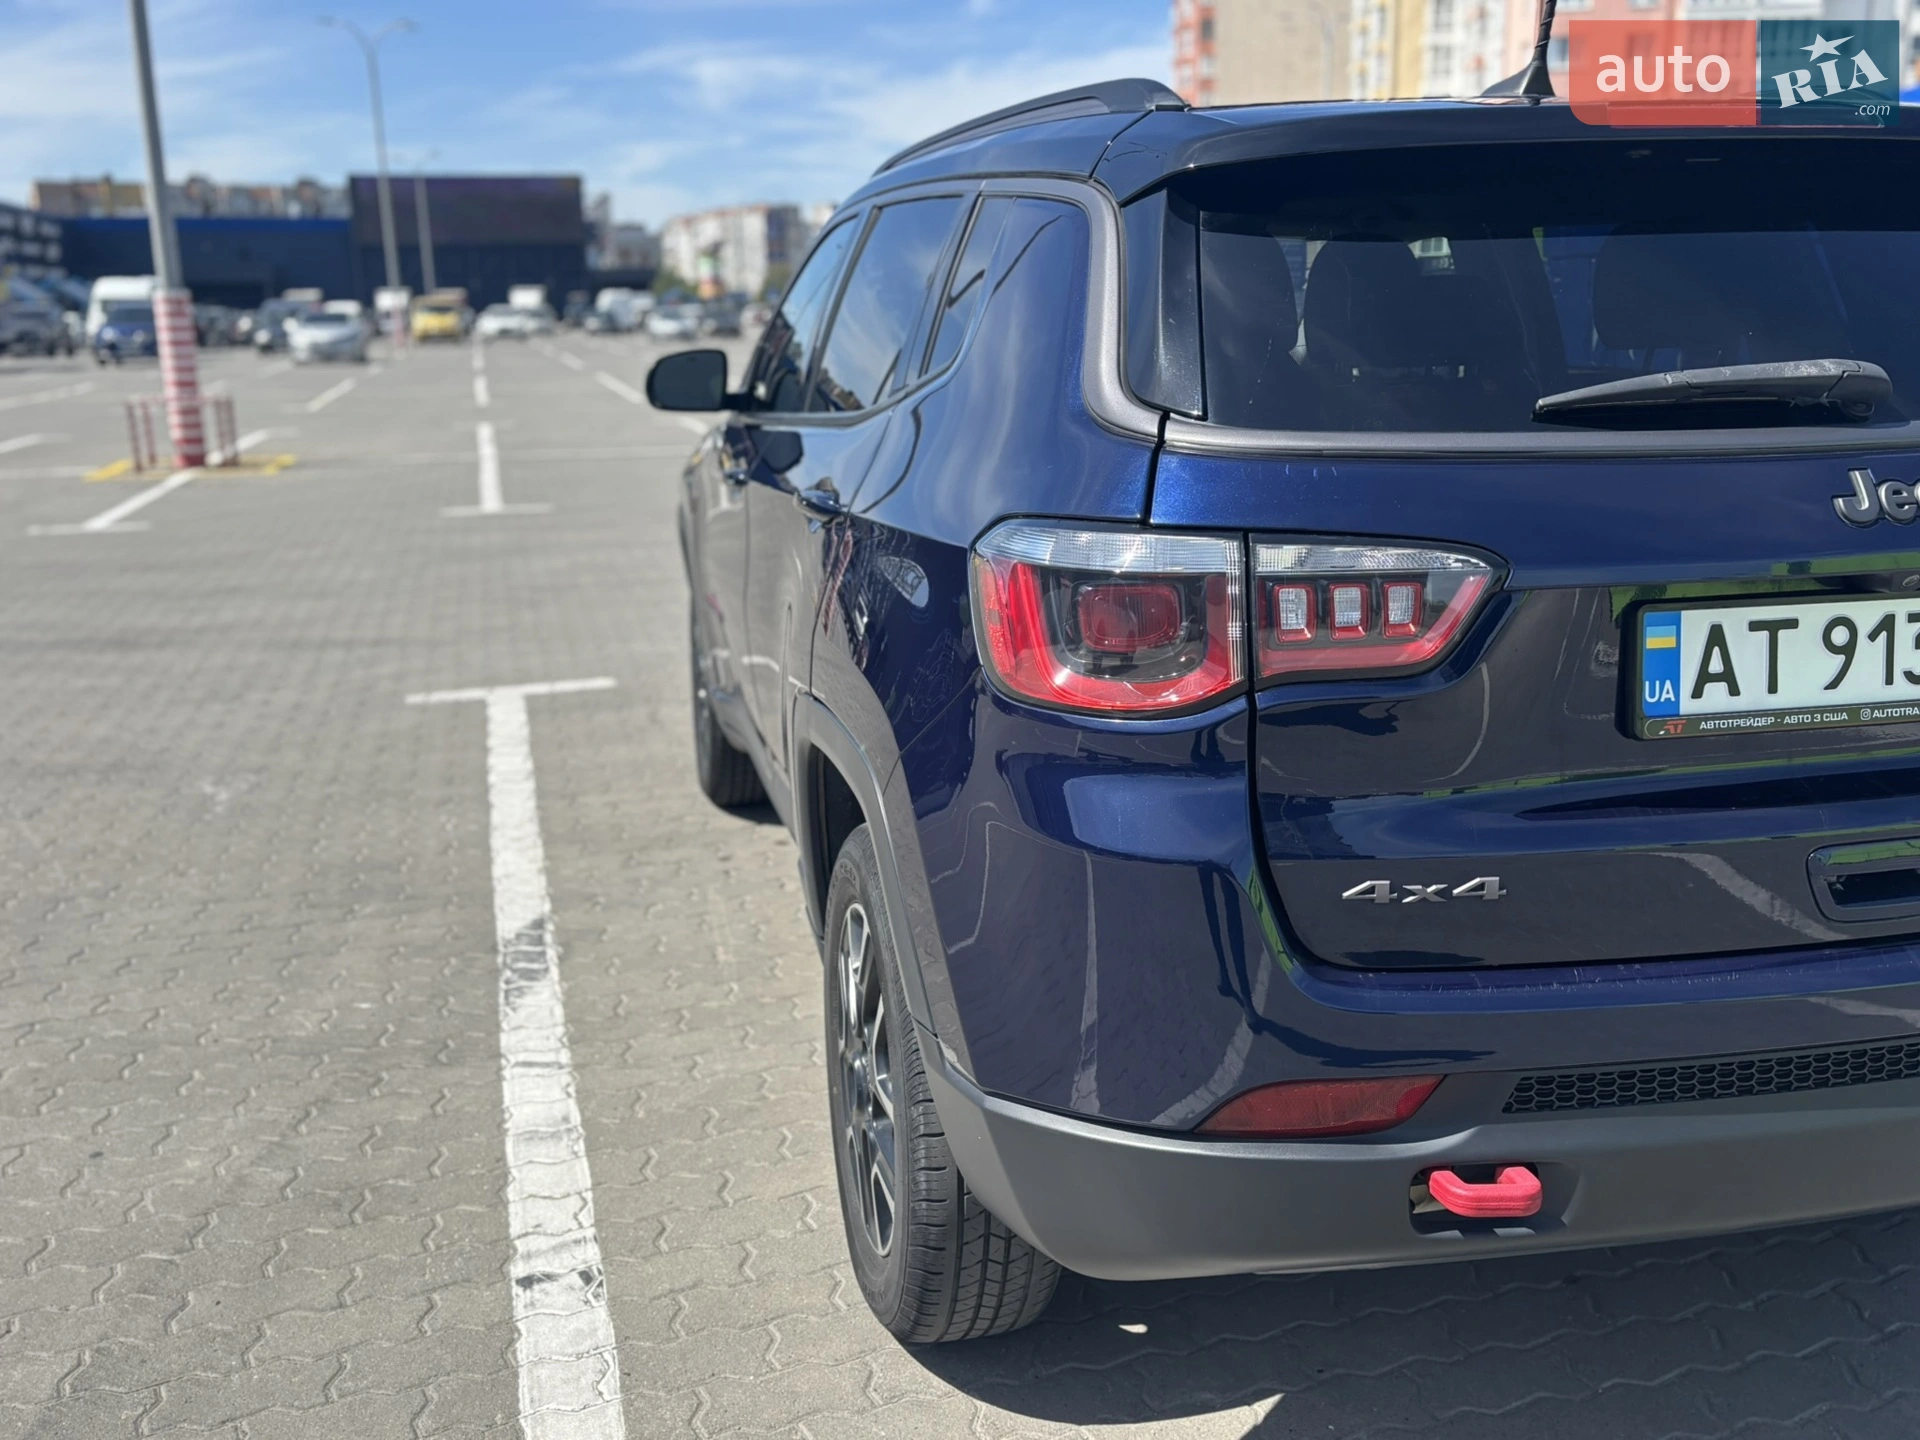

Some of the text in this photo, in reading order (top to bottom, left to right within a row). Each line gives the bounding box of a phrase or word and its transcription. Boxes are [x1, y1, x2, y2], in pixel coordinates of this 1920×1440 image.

[1831, 467, 1920, 528] Je
[1690, 617, 1799, 700] AT
[1644, 680, 1676, 703] UA
[1699, 715, 1775, 730] АВТОТРЕЙДЕР
[1783, 714, 1811, 725] АВТО
[1823, 712, 1849, 722] США
[1341, 876, 1507, 904] 4x4
